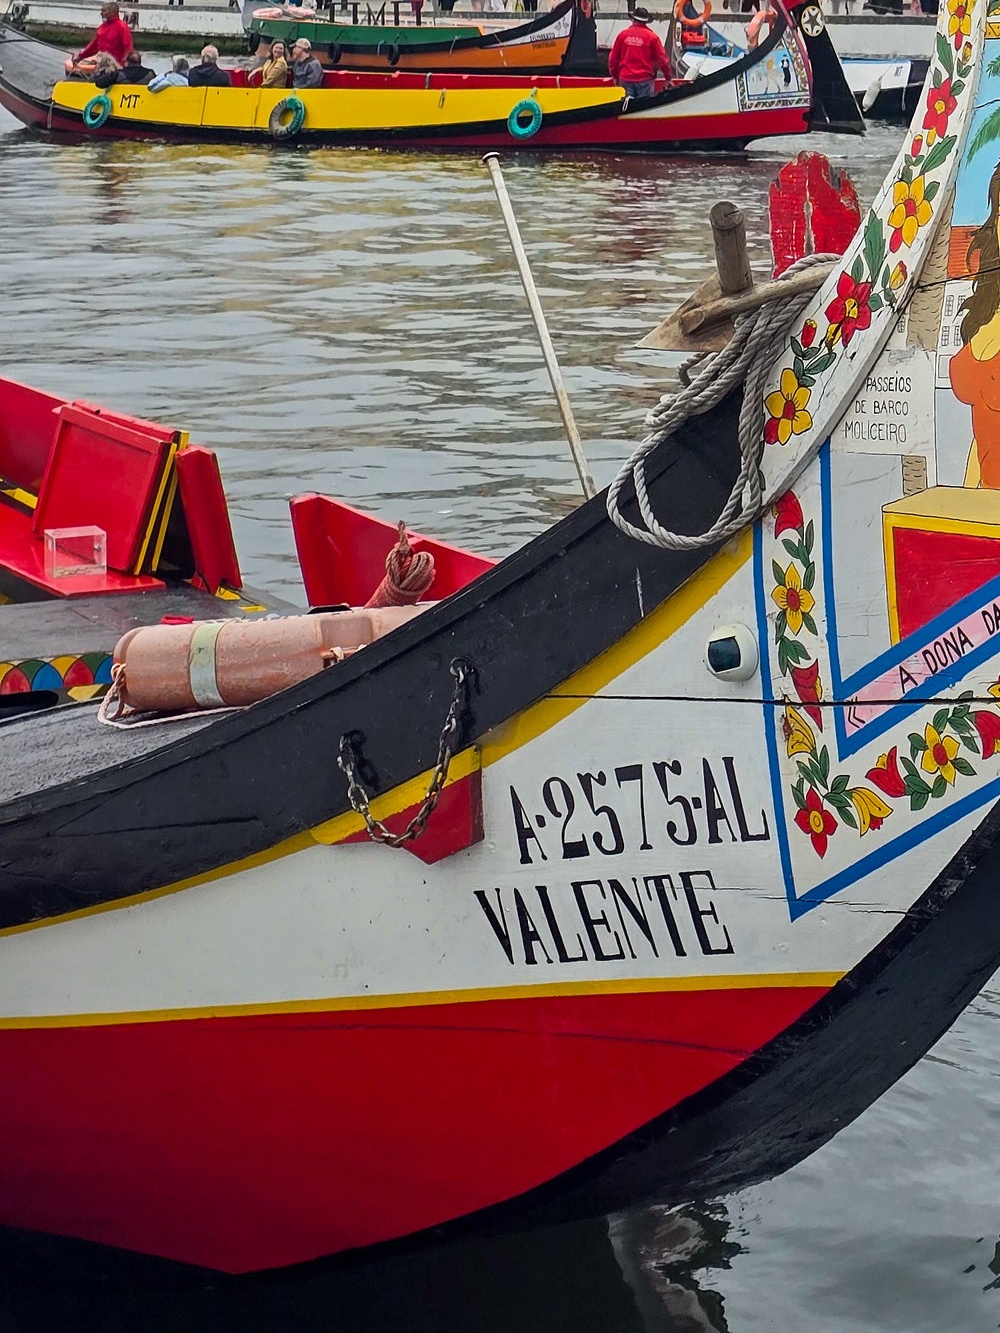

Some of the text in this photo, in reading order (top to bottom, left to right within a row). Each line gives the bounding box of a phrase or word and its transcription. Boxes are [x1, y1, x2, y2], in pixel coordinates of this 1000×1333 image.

[120, 94, 140, 108] MT
[855, 400, 909, 416] DE BARCO
[899, 665, 917, 694] A
[921, 627, 974, 675] DONA
[473, 870, 735, 965] VALENTE
